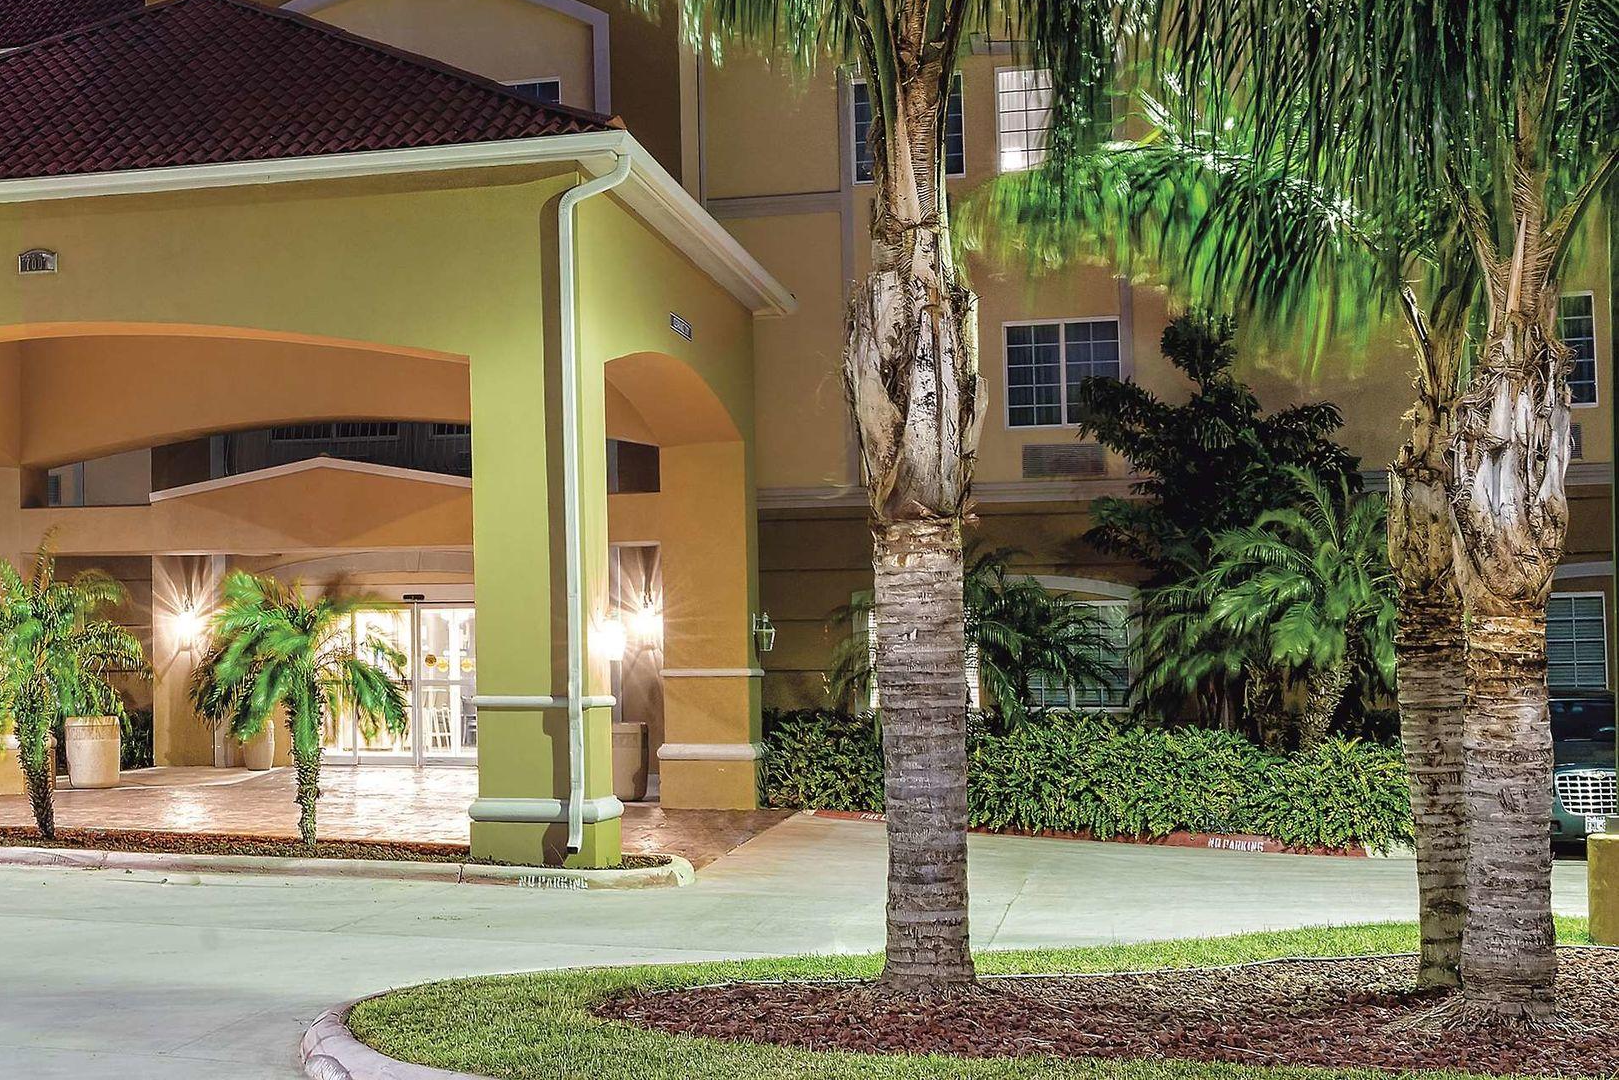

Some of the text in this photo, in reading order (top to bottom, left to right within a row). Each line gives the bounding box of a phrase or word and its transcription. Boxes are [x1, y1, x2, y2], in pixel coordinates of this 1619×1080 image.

[1208, 837, 1264, 852] NO PARKING
[537, 875, 588, 890] PARKING
